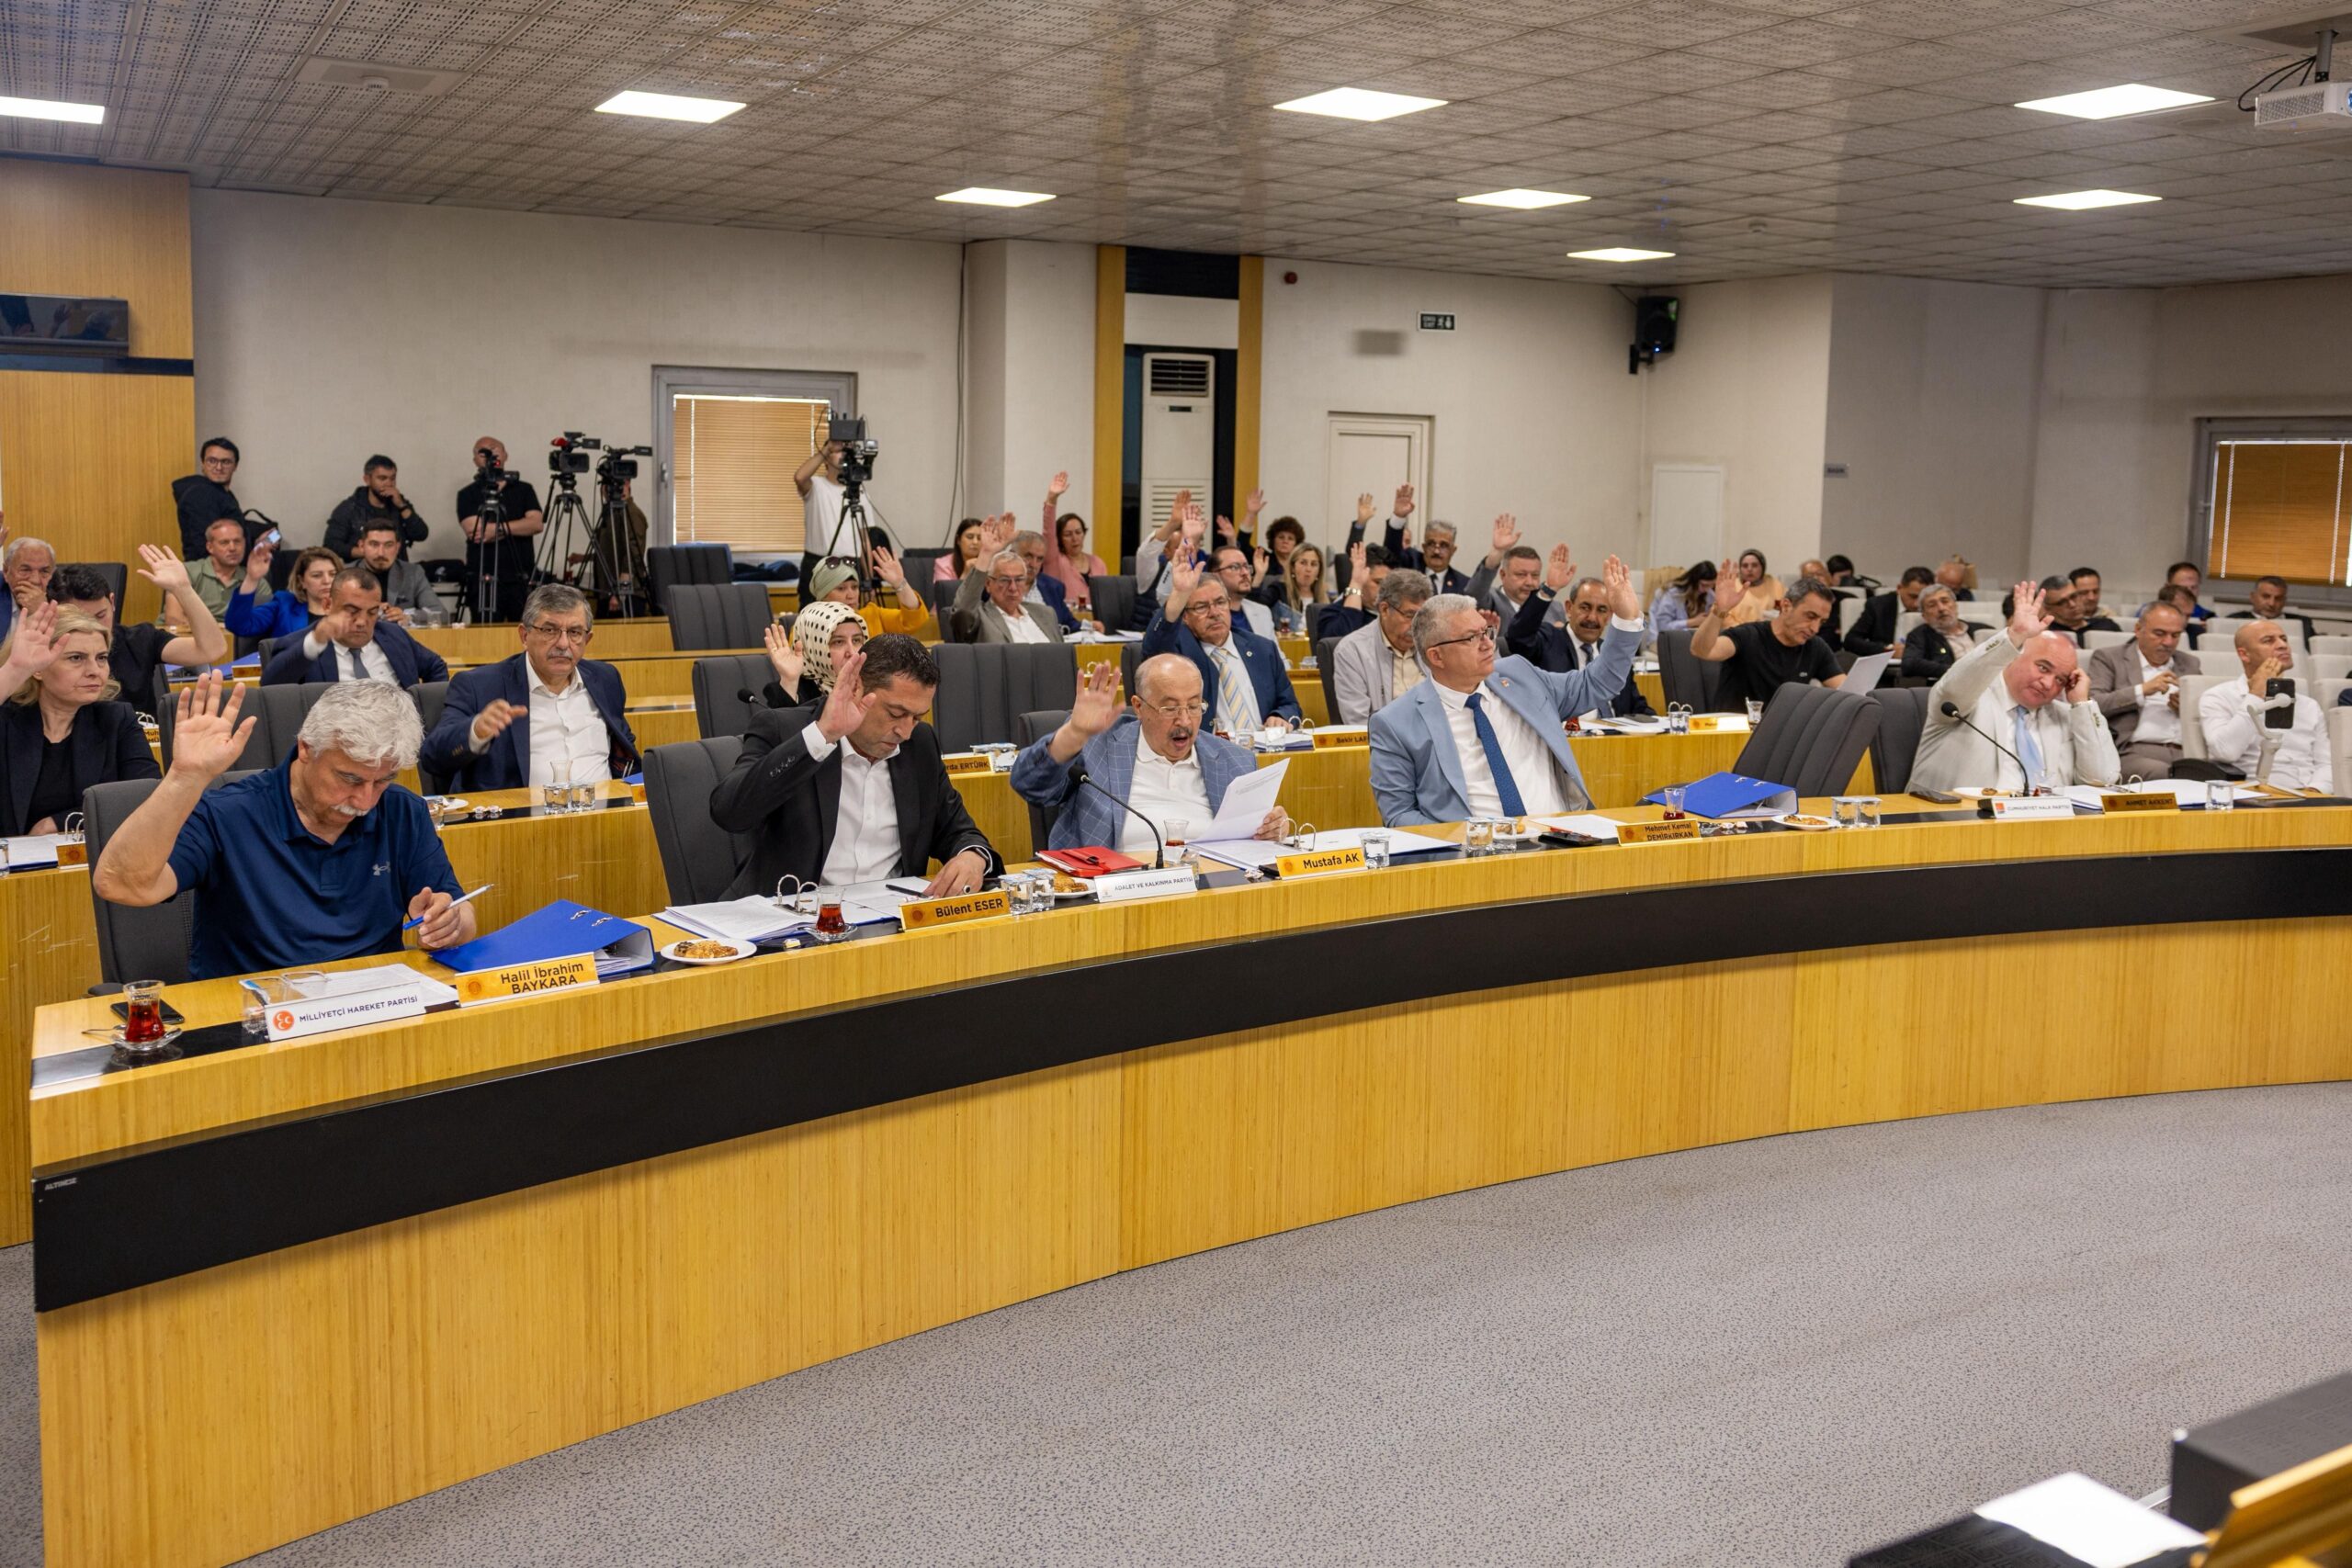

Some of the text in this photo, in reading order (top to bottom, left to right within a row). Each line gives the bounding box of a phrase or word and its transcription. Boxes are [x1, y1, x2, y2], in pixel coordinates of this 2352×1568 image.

[960, 761, 989, 770] ERTÜRK
[1672, 822, 1692, 830] Kemal
[1303, 852, 1360, 869] Mustafa AK
[1114, 883, 1136, 891] ADALET
[1145, 879, 1173, 887] KALKINMA
[935, 898, 1003, 918] Bülent ESER
[500, 963, 584, 984] Halil İbrahim
[511, 975, 578, 994] BAYKARA
[299, 996, 419, 1022] MİLLİYETÇİ HAREKET PARTİSİ
